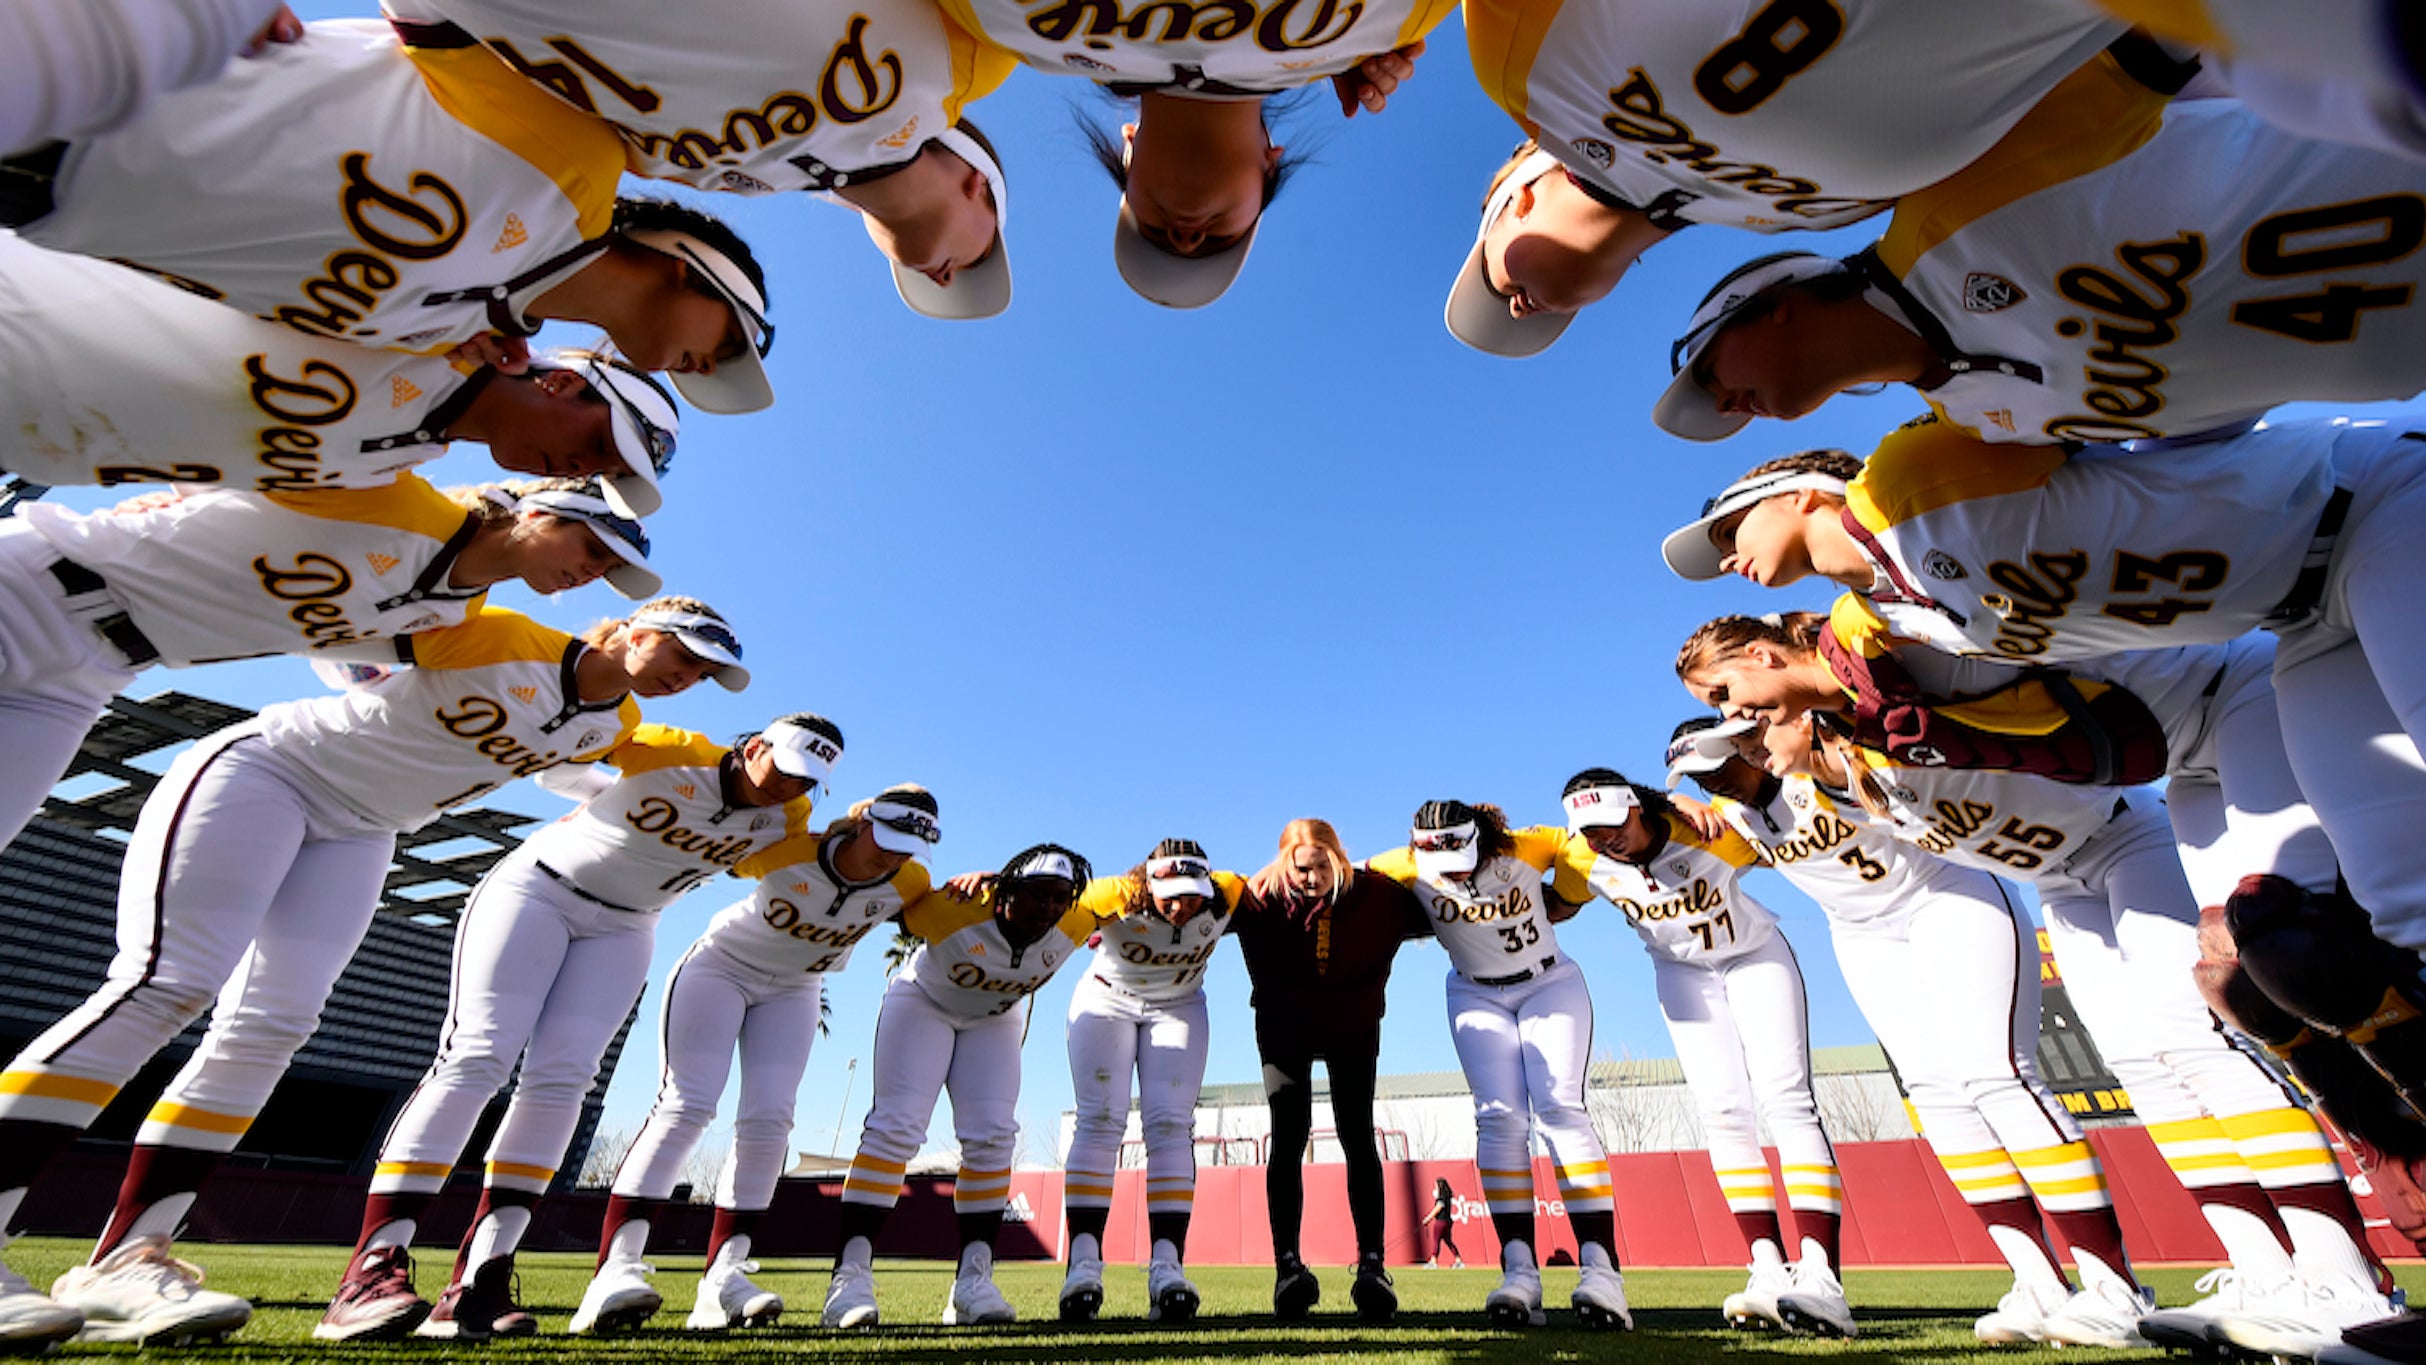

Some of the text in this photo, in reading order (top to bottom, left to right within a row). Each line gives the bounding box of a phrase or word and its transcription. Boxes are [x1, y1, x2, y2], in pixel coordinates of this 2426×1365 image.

[1692, 0, 1847, 116] 8
[252, 151, 471, 345] Devi
[2229, 192, 2426, 344] 40
[243, 352, 360, 493] Devi
[1959, 549, 2088, 667] evils
[2101, 549, 2230, 626] 43
[434, 695, 563, 778] Devi
[805, 737, 839, 765] ASU
[1572, 791, 1601, 809] ASU
[1838, 844, 1889, 882] 3
[1975, 814, 2067, 870] 55
[1431, 885, 1533, 924] Devils
[1612, 877, 1724, 922] Devils
[1497, 915, 1541, 954] 33
[1687, 907, 1736, 951] 77
